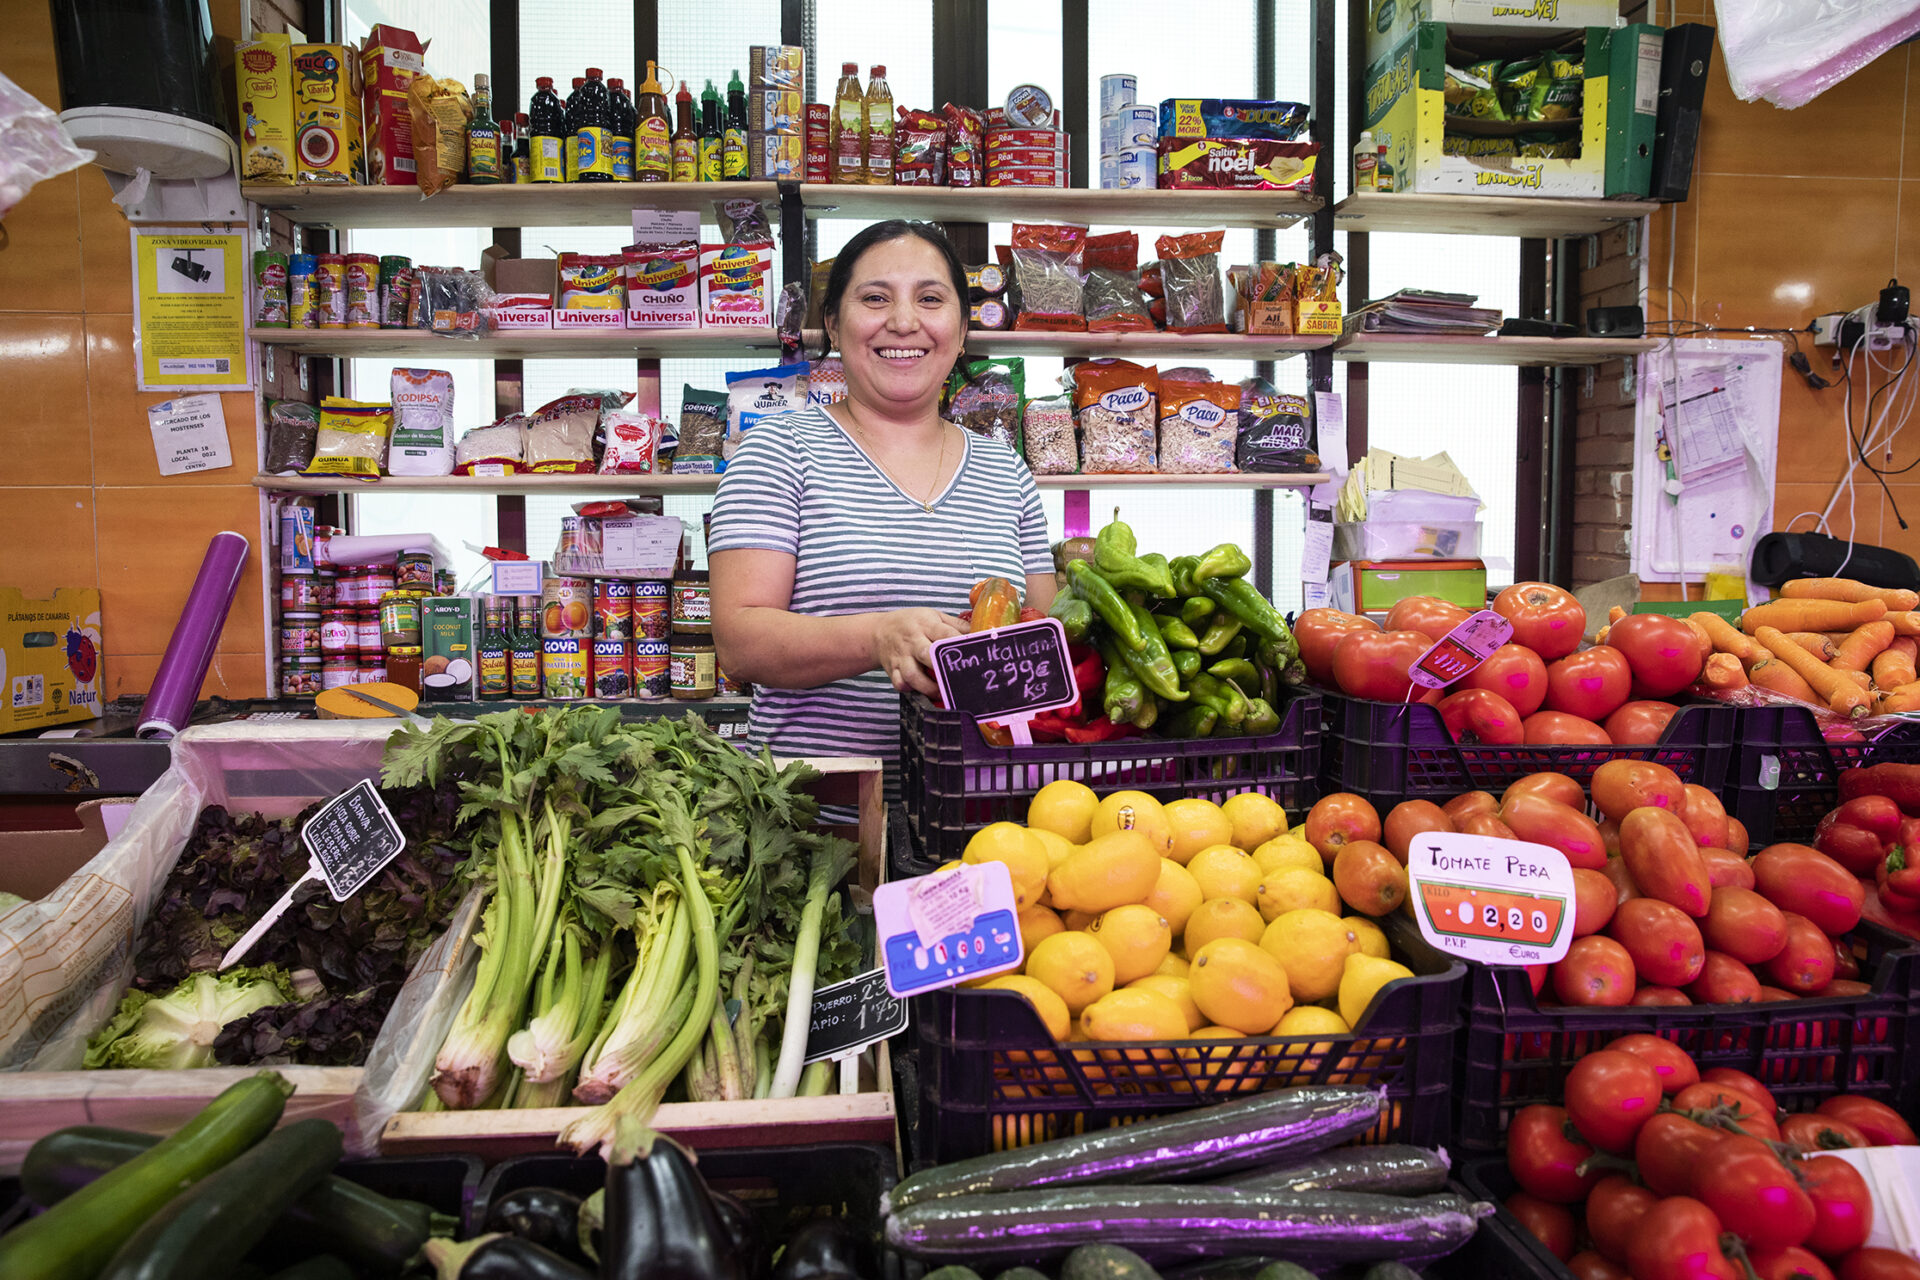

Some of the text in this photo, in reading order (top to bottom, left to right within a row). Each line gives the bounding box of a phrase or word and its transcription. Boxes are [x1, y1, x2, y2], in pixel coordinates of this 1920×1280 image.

[810, 110, 829, 120] Real
[472, 130, 494, 138] GOYA
[1178, 126, 1201, 134] MORE
[998, 134, 1014, 142] Real
[1208, 148, 1237, 158] Saltin
[1208, 151, 1256, 172] noel
[998, 172, 1014, 180] Real
[1180, 172, 1188, 182] 3
[152, 238, 228, 246] ZONA VIDEOVIGILADA
[712, 256, 760, 270] Universal
[572, 270, 618, 287] Universal
[636, 266, 688, 284] Universal
[642, 294, 685, 304] CHUÑO
[498, 310, 549, 322] niversal
[556, 310, 623, 322] Universal
[630, 310, 696, 322] Universal
[704, 312, 769, 325] Universal
[1306, 320, 1338, 330] SABORA
[396, 393, 440, 403] CODIPSA
[1106, 391, 1145, 408] Paca
[753, 400, 789, 410] QUAKER
[1186, 406, 1220, 423] Paca
[170, 422, 204, 432] MOSTENSES
[1272, 424, 1304, 437] MAÍZ
[176, 448, 198, 456] PLANTA
[184, 462, 206, 470] CENTRO
[636, 585, 667, 596] GOYA
[38, 612, 46, 621] DE
[46, 612, 70, 621] CANARIAS
[544, 641, 578, 653] GOYA
[637, 644, 670, 654] GOYA
[482, 651, 504, 659] GOYA
[69, 690, 97, 706] Natur
[1427, 846, 1551, 880] TOMATE PERA
